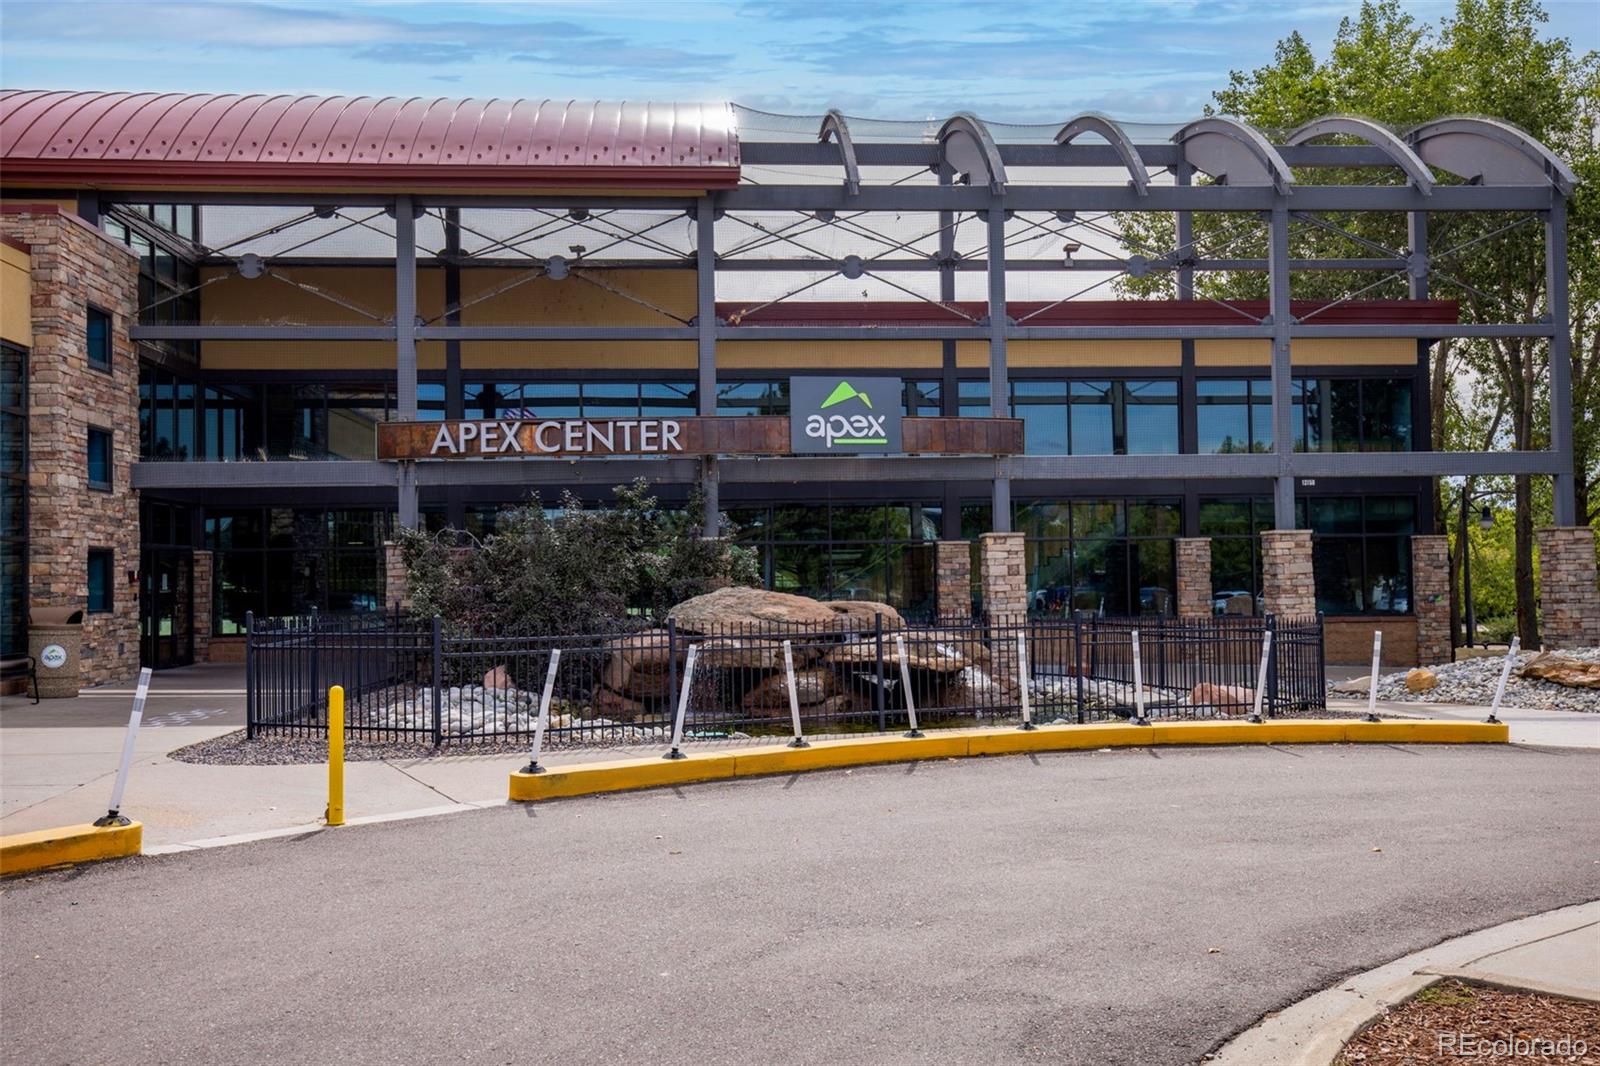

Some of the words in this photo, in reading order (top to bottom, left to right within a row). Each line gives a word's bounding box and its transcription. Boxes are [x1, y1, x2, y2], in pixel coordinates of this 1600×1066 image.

[430, 421, 523, 454] APEX
[534, 420, 683, 453] CENTER
[805, 414, 886, 448] apex
